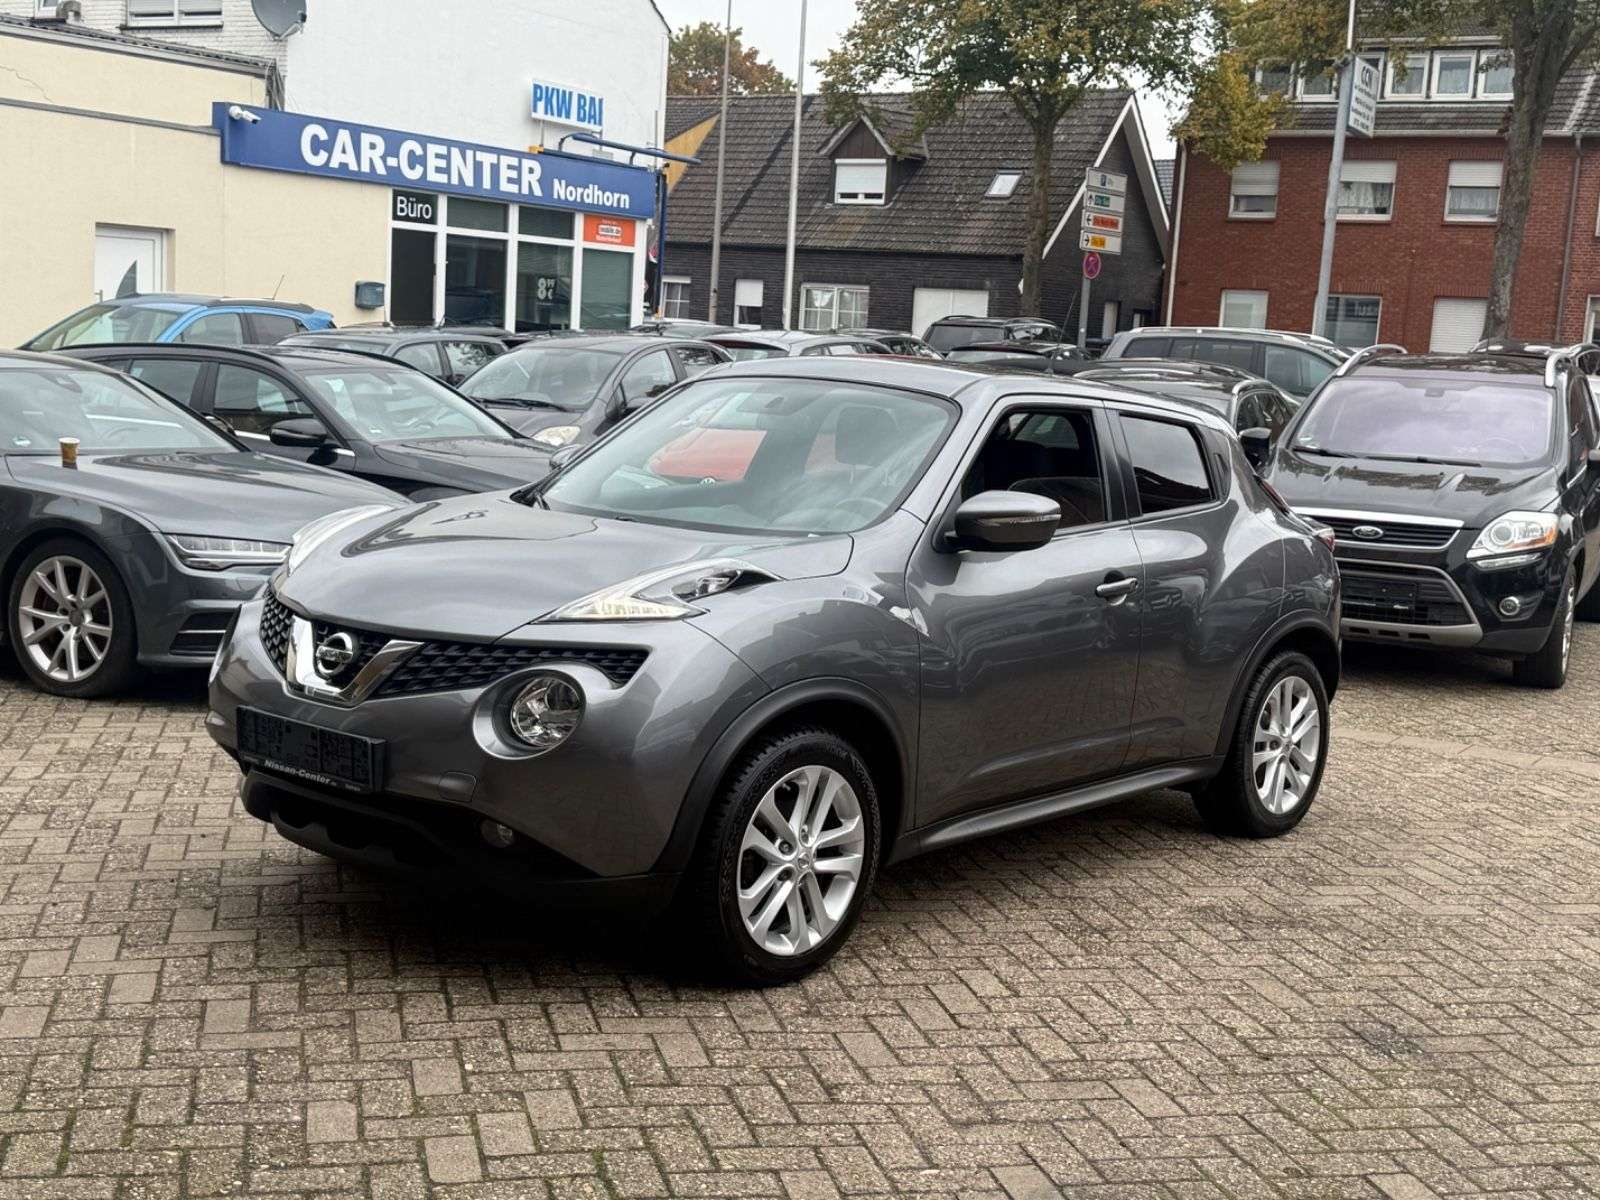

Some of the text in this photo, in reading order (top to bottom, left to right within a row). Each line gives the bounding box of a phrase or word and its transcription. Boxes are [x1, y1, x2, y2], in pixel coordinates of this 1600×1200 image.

[532, 83, 573, 119] PKW
[300, 124, 630, 209] CAR-CENTER Nordhorn
[397, 195, 432, 219] Büro
[264, 759, 331, 785] Nissan-Center
